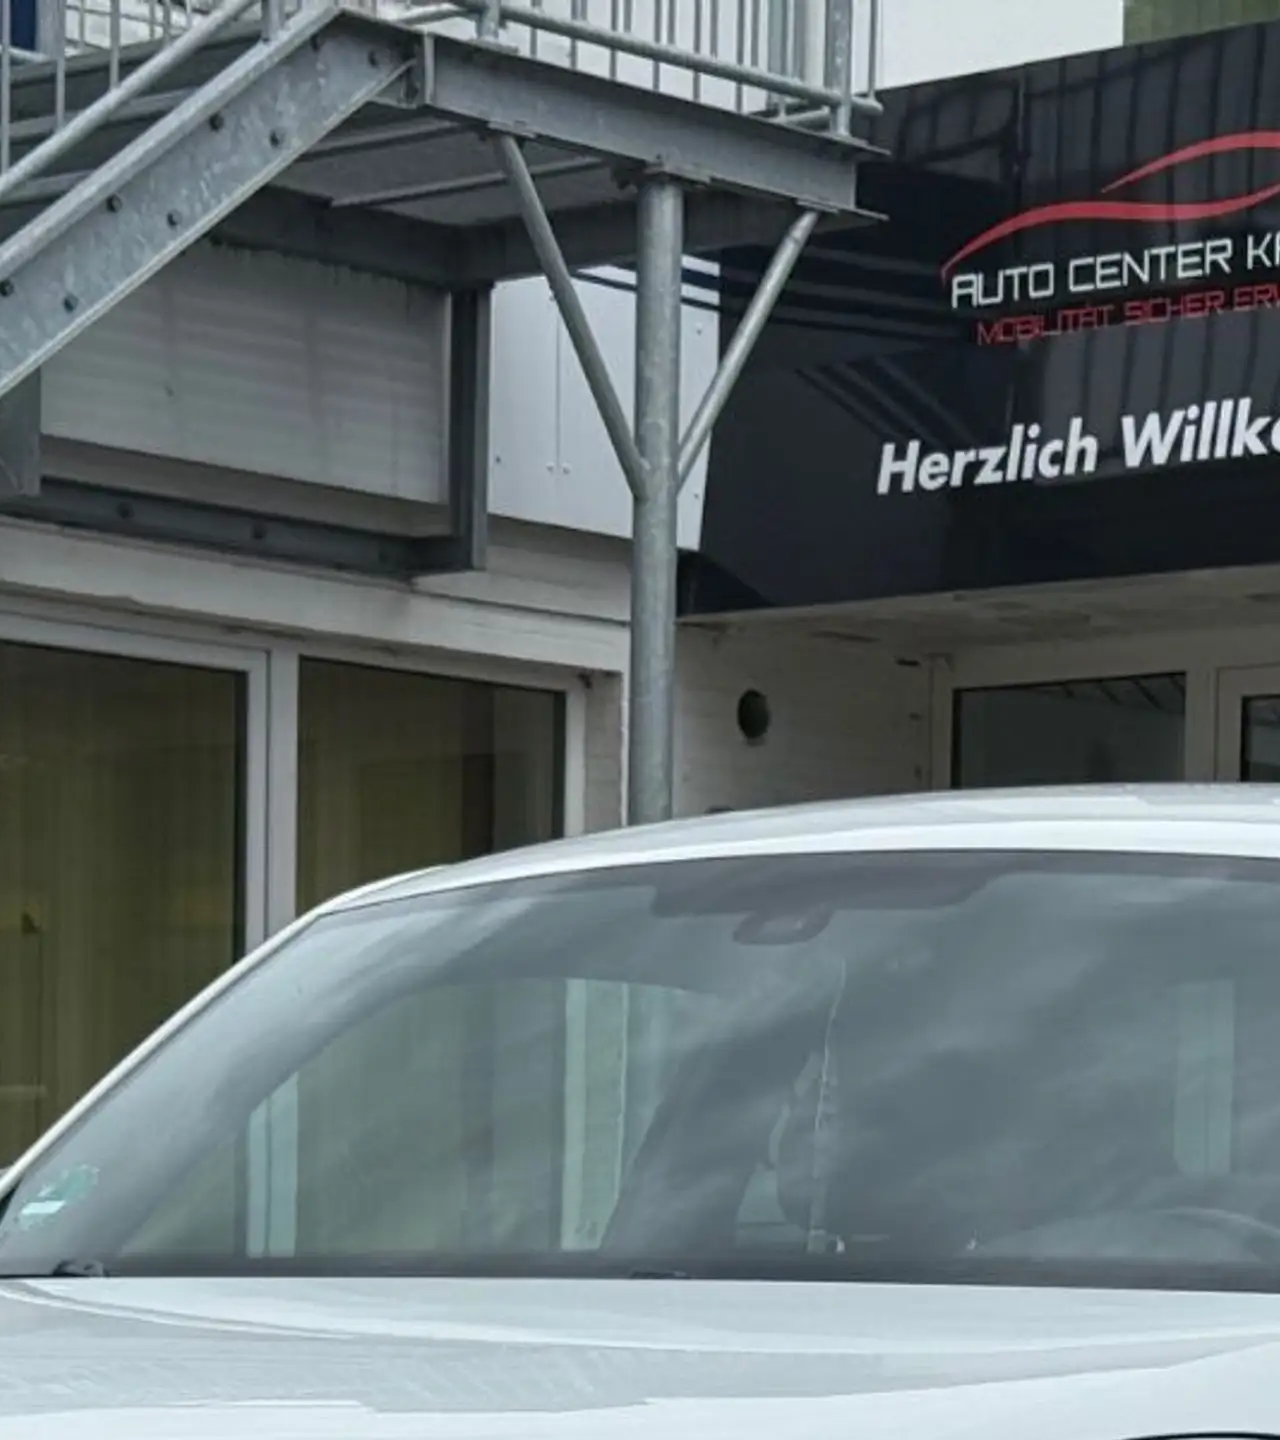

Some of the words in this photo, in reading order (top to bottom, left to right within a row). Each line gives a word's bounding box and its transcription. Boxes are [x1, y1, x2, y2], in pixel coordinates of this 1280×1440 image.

[952, 263, 1054, 309] AUTO
[1068, 238, 1233, 292] CENTER
[1125, 290, 1225, 327] SICHER
[877, 417, 1098, 494] Herzlich
